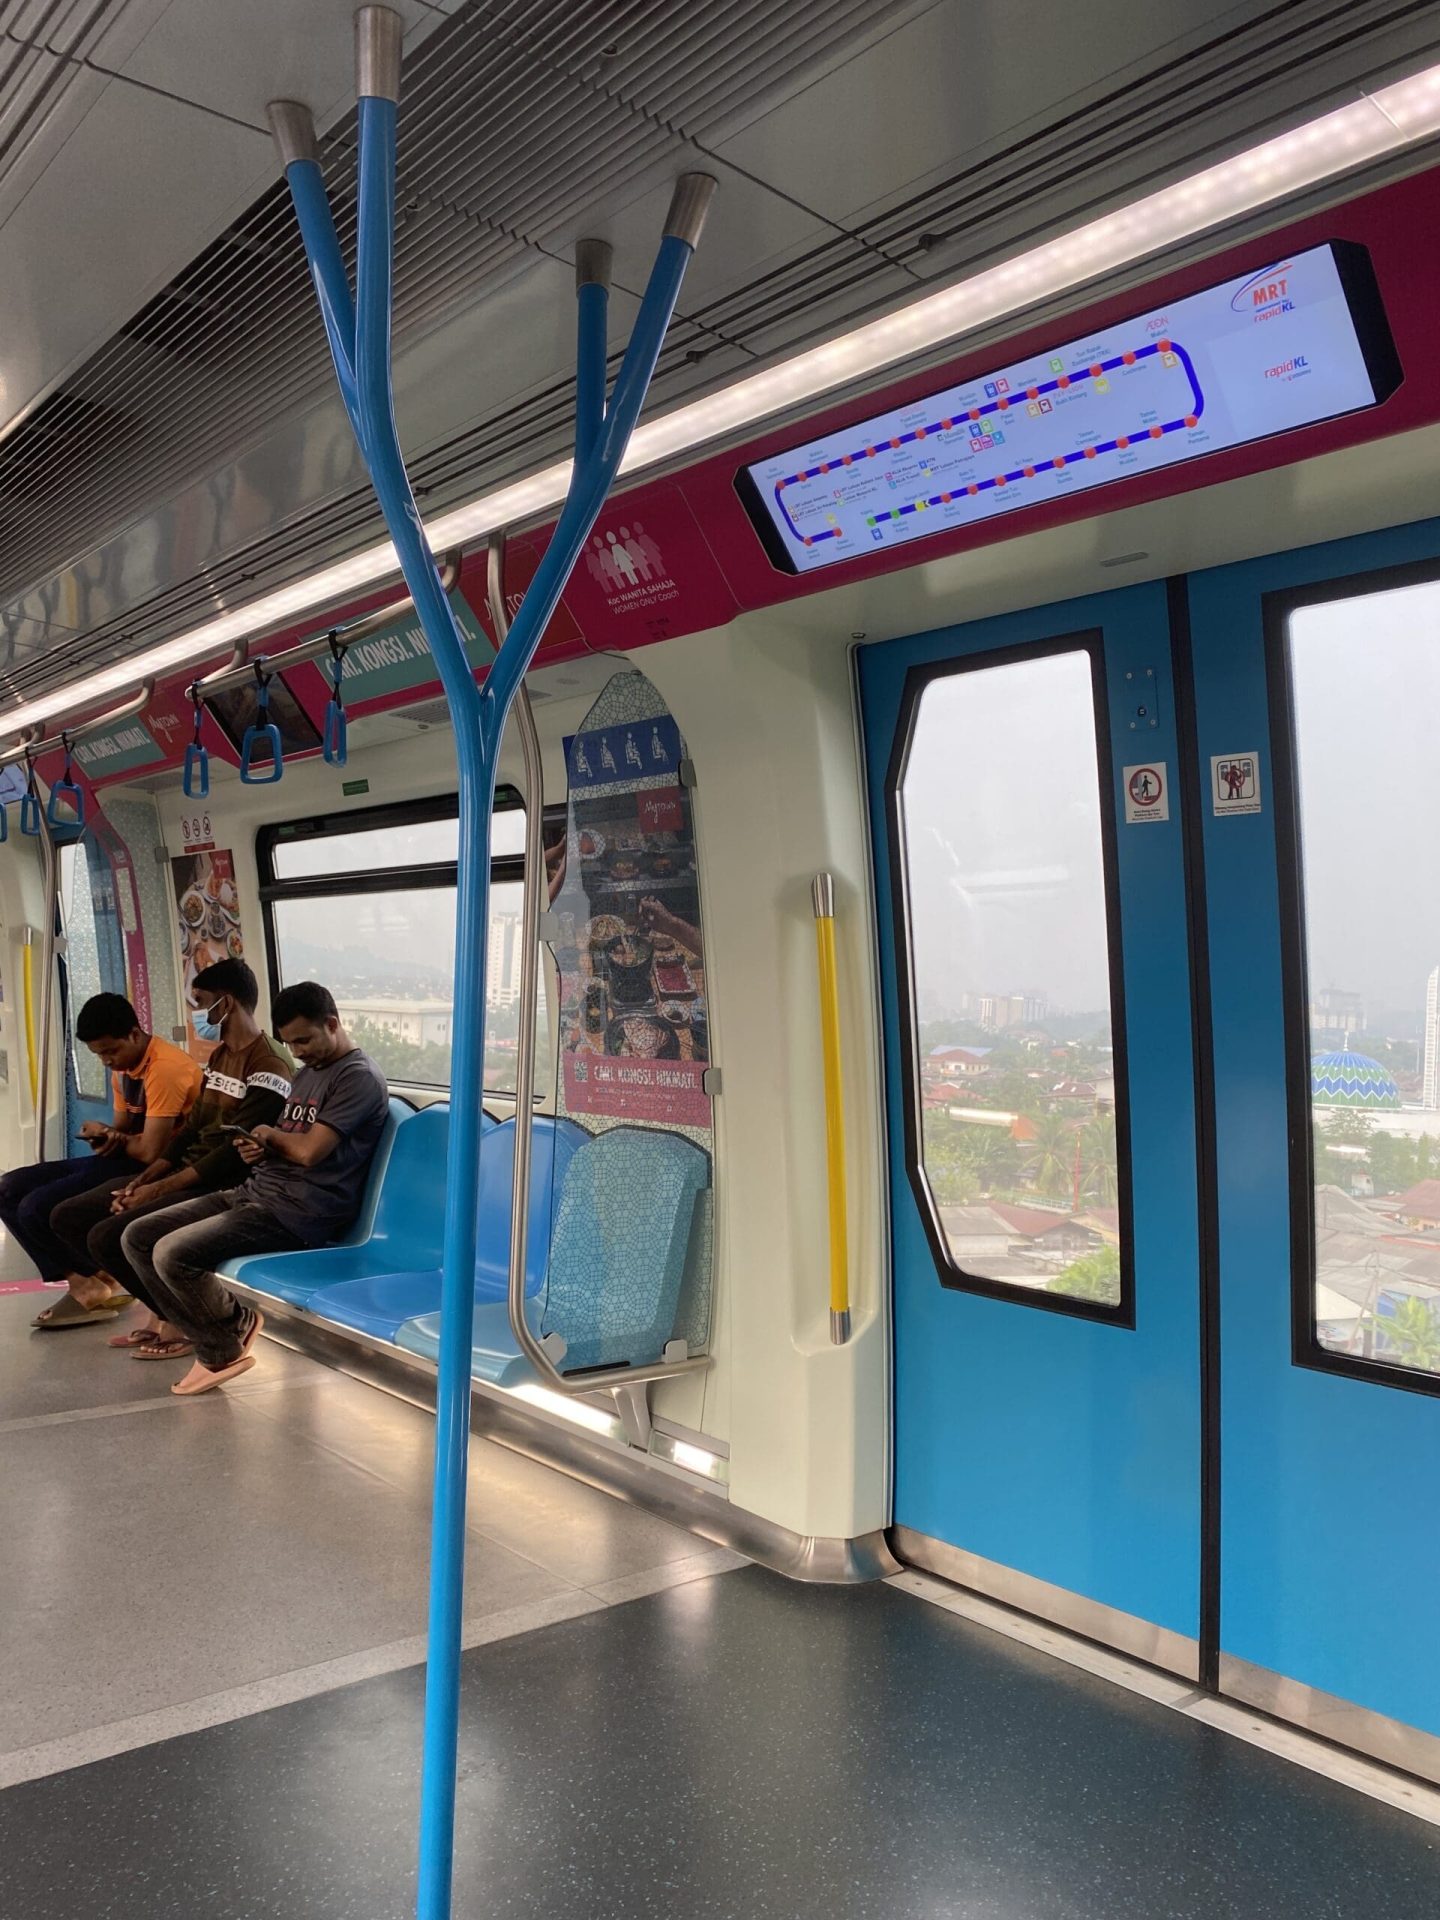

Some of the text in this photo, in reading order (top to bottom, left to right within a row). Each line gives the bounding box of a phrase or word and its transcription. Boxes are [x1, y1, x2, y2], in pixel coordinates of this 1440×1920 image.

[1253, 279, 1288, 305] MRT
[1254, 302, 1295, 323] rapidKL
[1264, 356, 1308, 379] rapidKL
[613, 590, 679, 614] WOMEN ONLY Coach
[620, 587, 647, 602] WANITA
[647, 579, 675, 594] SAHAJA
[355, 635, 412, 672] KONGSI.
